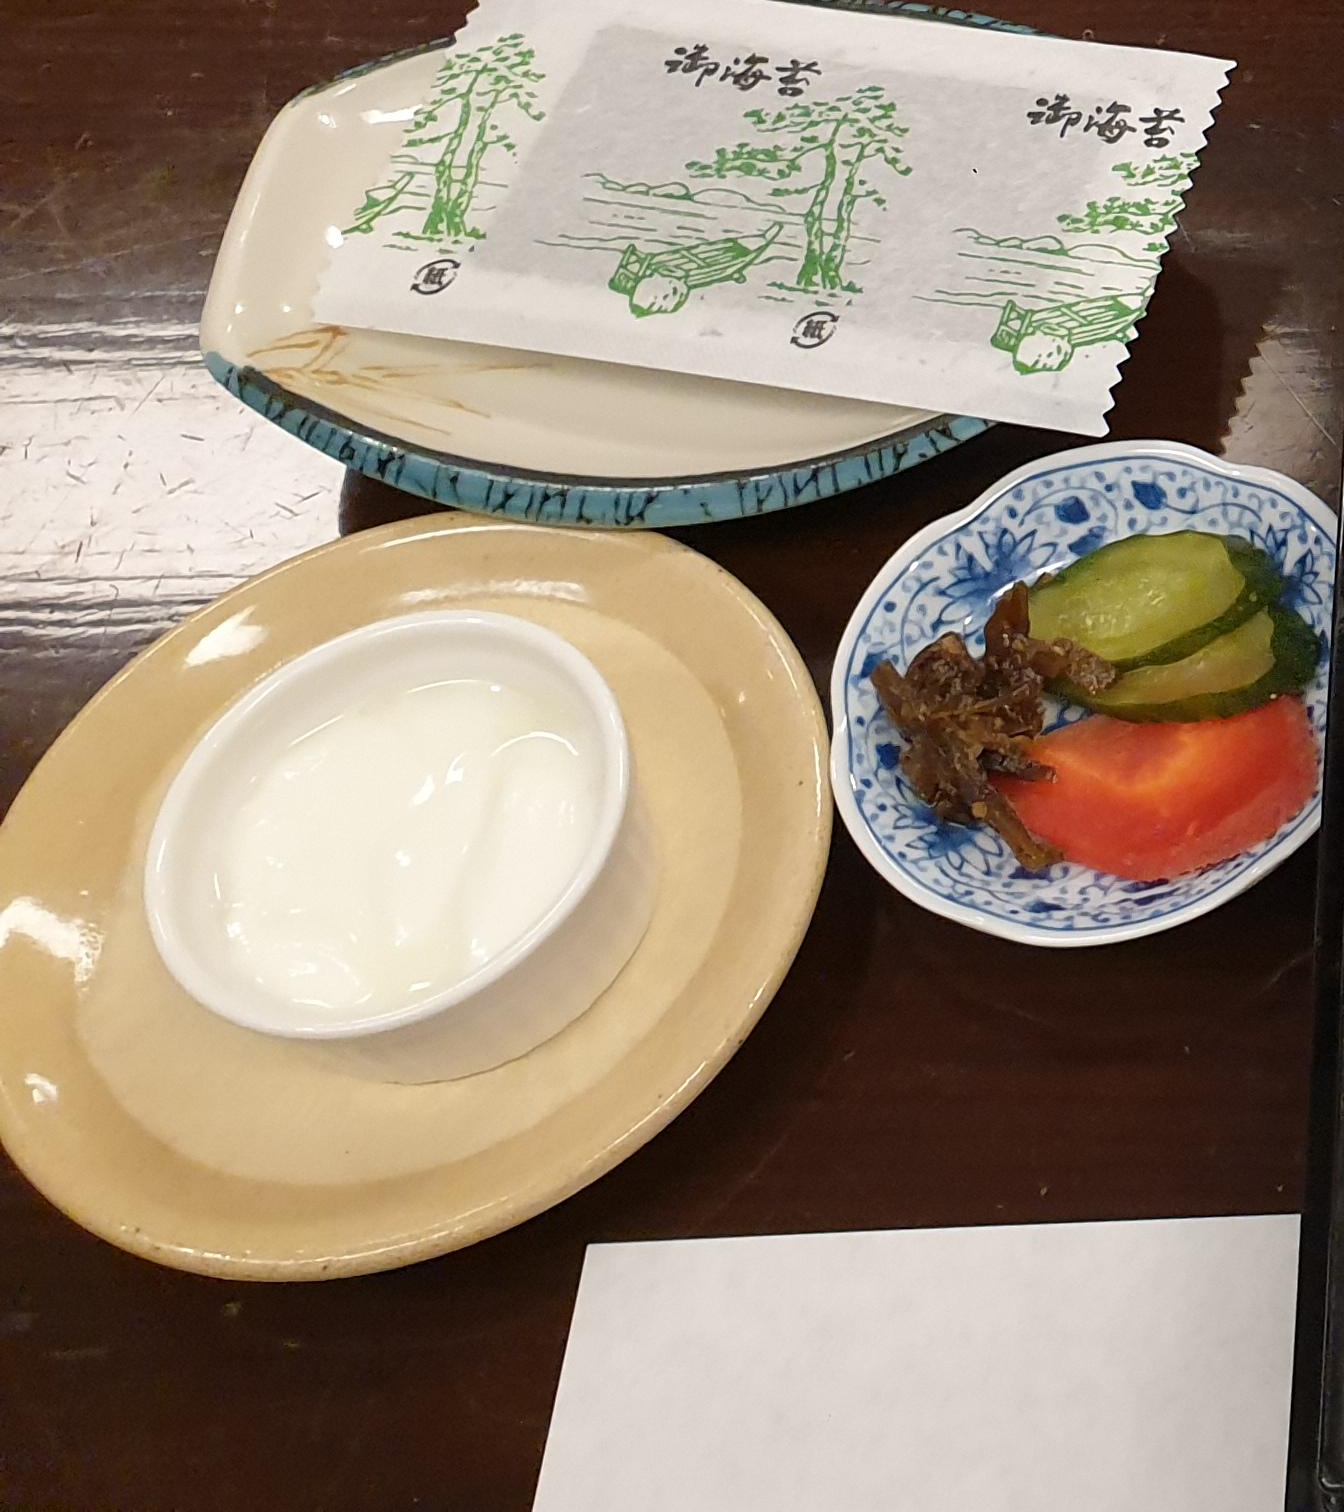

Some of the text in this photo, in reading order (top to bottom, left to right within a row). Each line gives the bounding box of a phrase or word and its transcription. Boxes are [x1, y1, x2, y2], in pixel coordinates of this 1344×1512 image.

[664, 43, 823, 97] 御海苔
[1026, 92, 1186, 149] 御海苔
